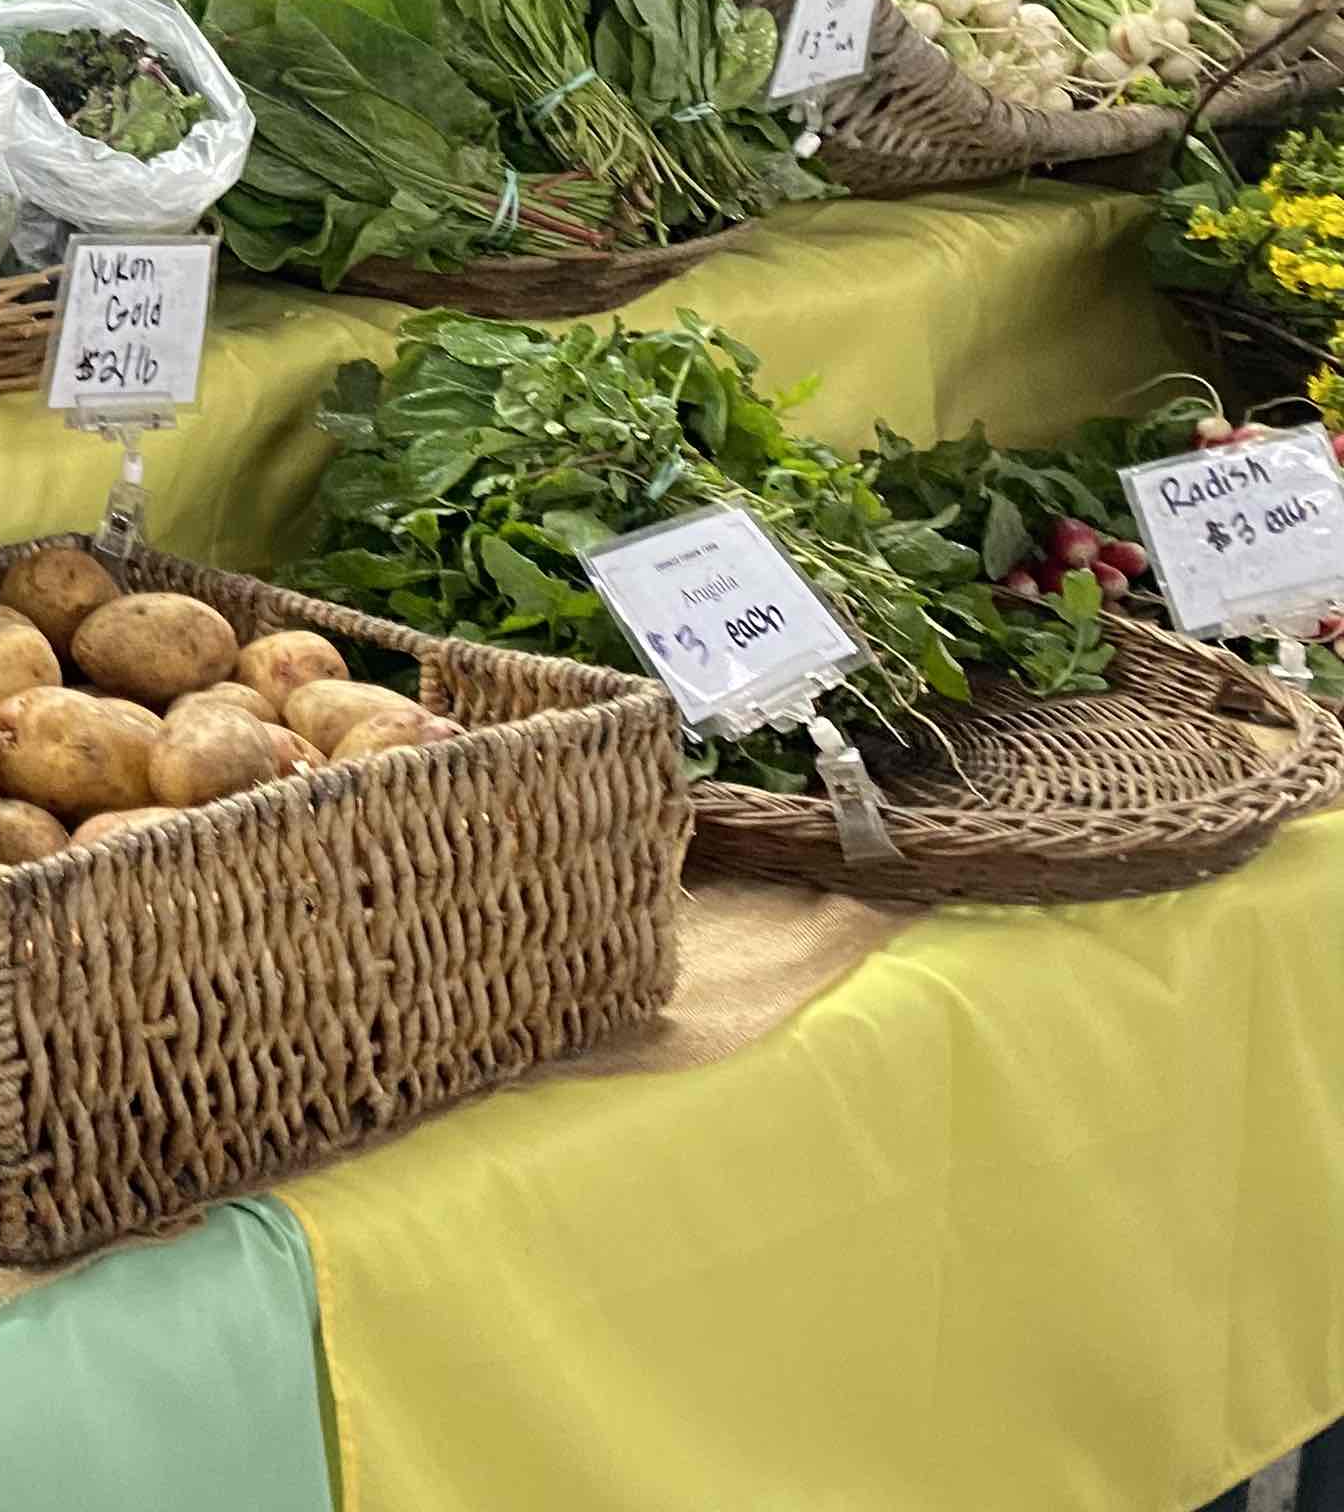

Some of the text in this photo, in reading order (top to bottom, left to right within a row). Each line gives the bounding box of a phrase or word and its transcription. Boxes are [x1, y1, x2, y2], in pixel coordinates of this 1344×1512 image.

[105, 293, 164, 332] Gold
[1160, 456, 1272, 517] Radish
[1206, 510, 1256, 554] $3
[724, 604, 785, 649] each
